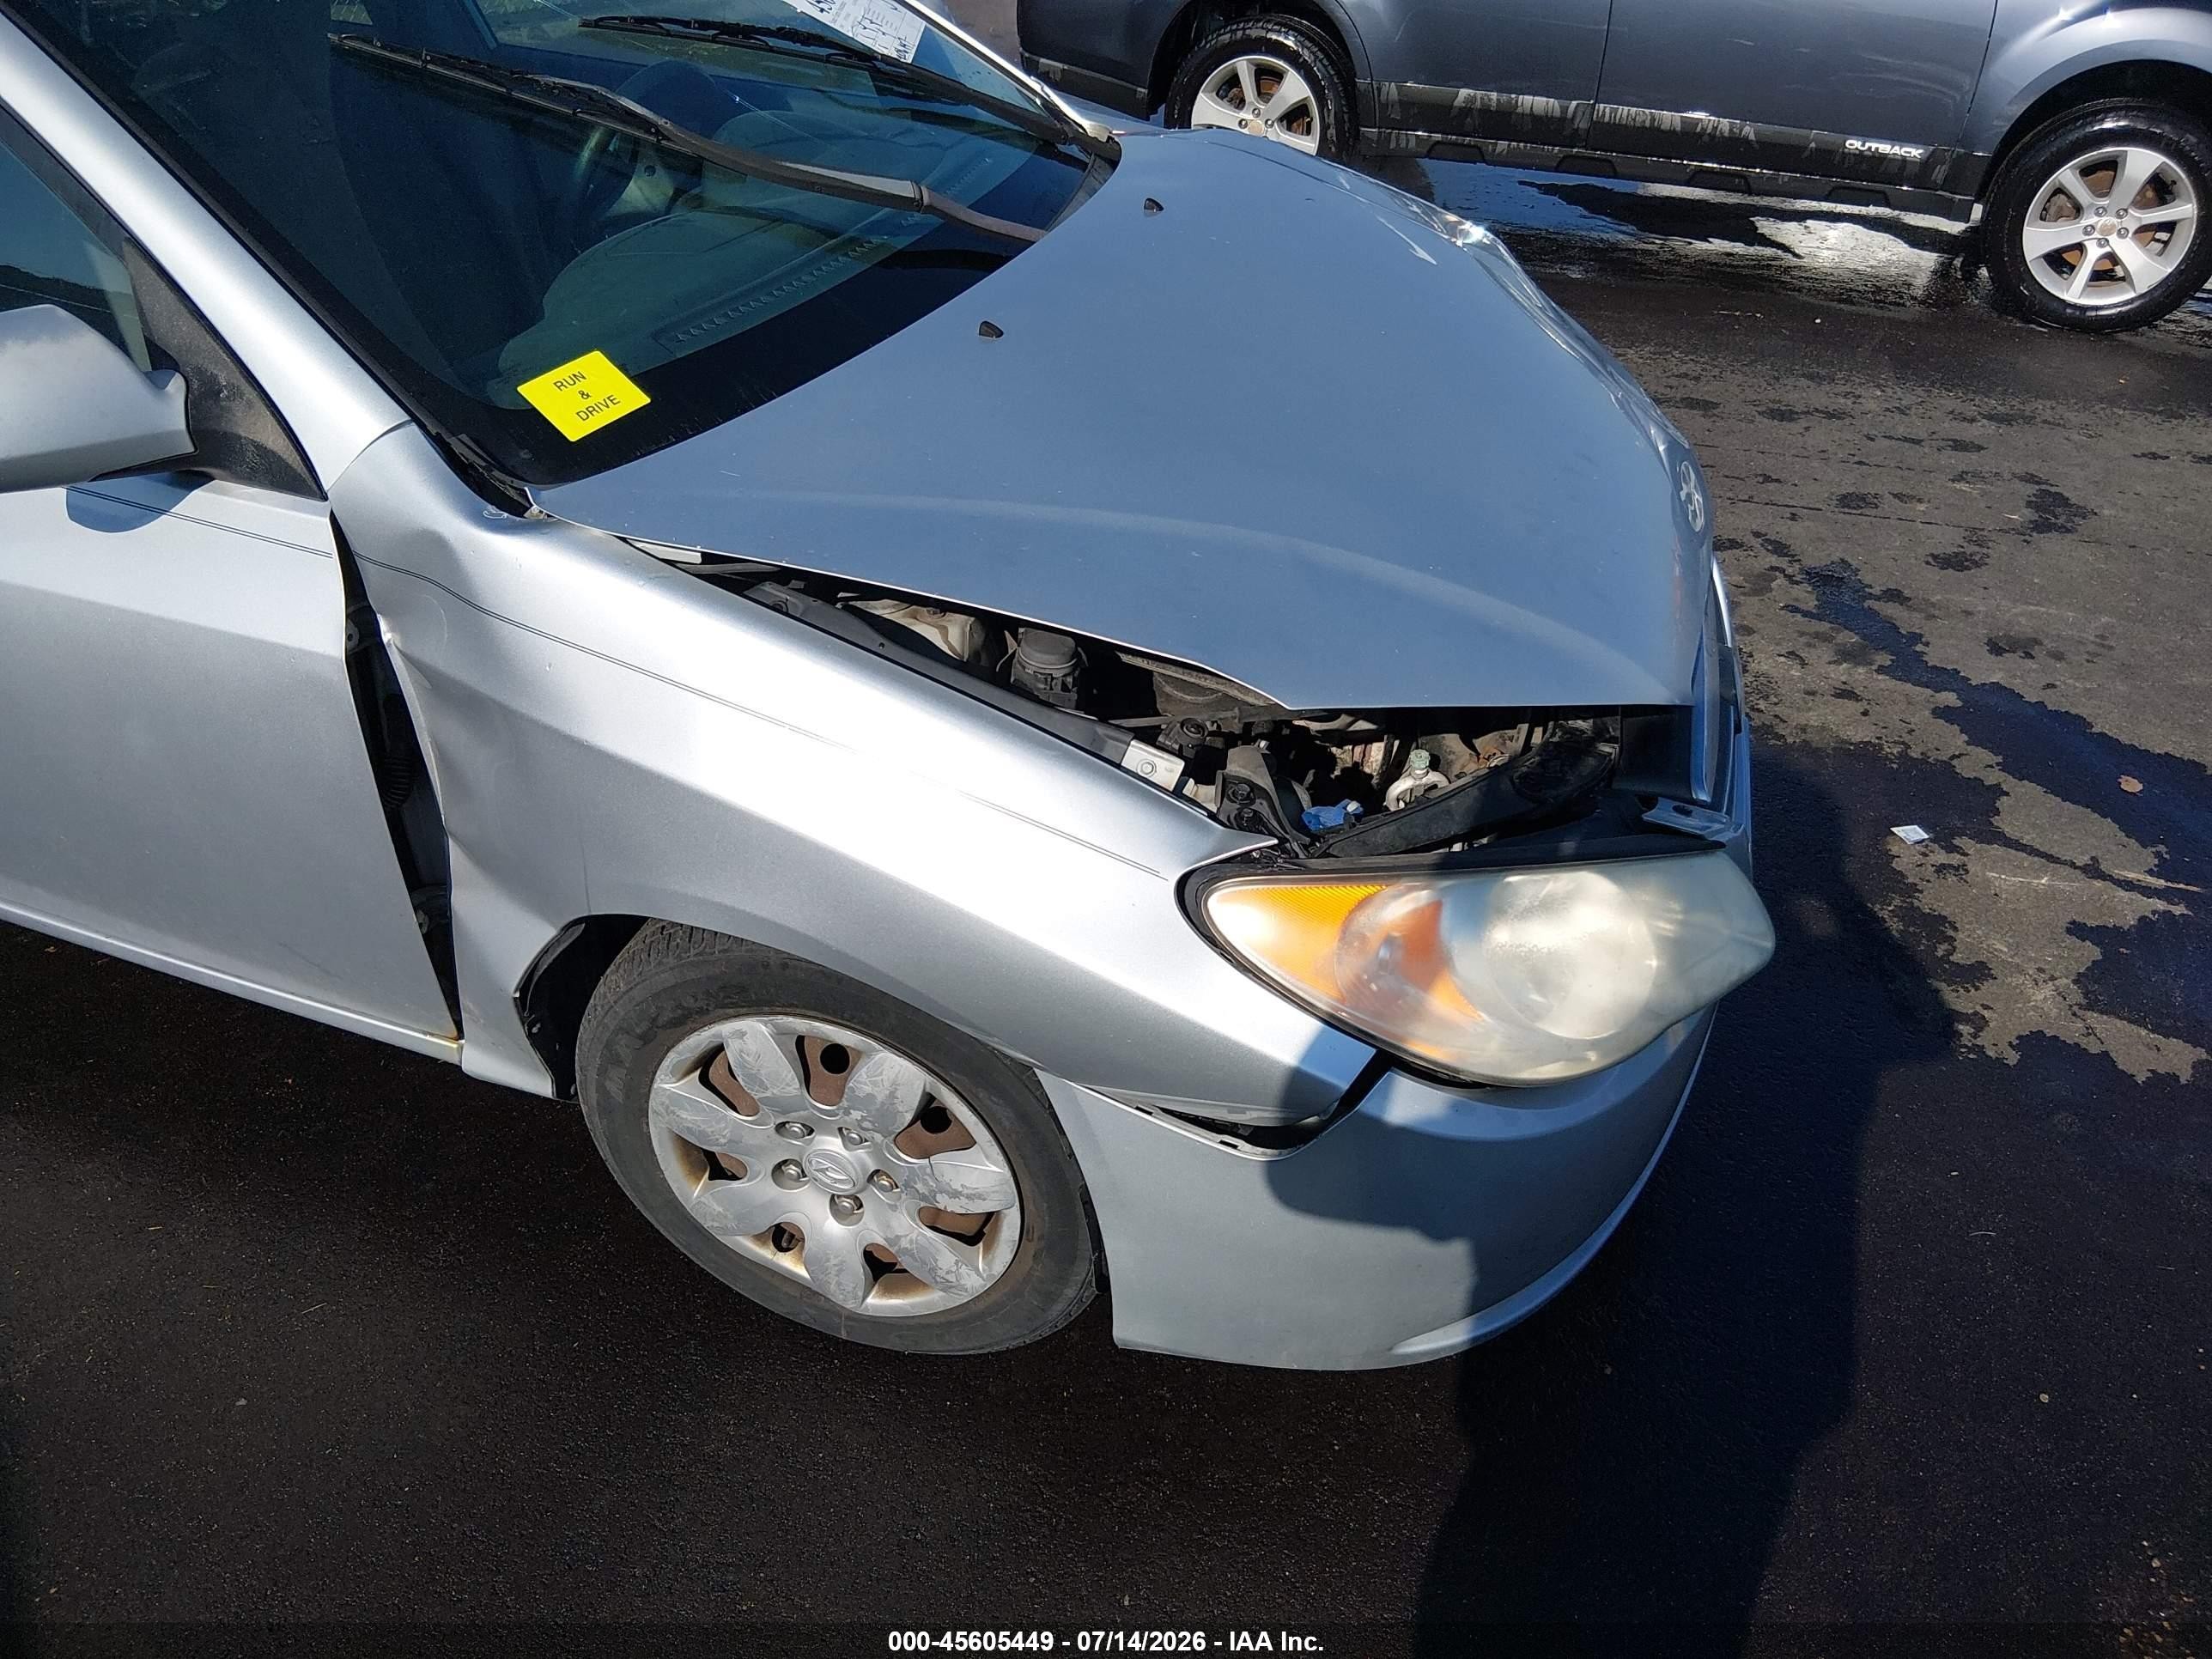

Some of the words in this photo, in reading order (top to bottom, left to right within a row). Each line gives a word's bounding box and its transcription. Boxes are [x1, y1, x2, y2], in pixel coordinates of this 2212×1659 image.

[1845, 139, 1924, 159] OUTBACK
[553, 371, 587, 392] RUN
[578, 390, 592, 400] &
[576, 394, 622, 422] DRIVE
